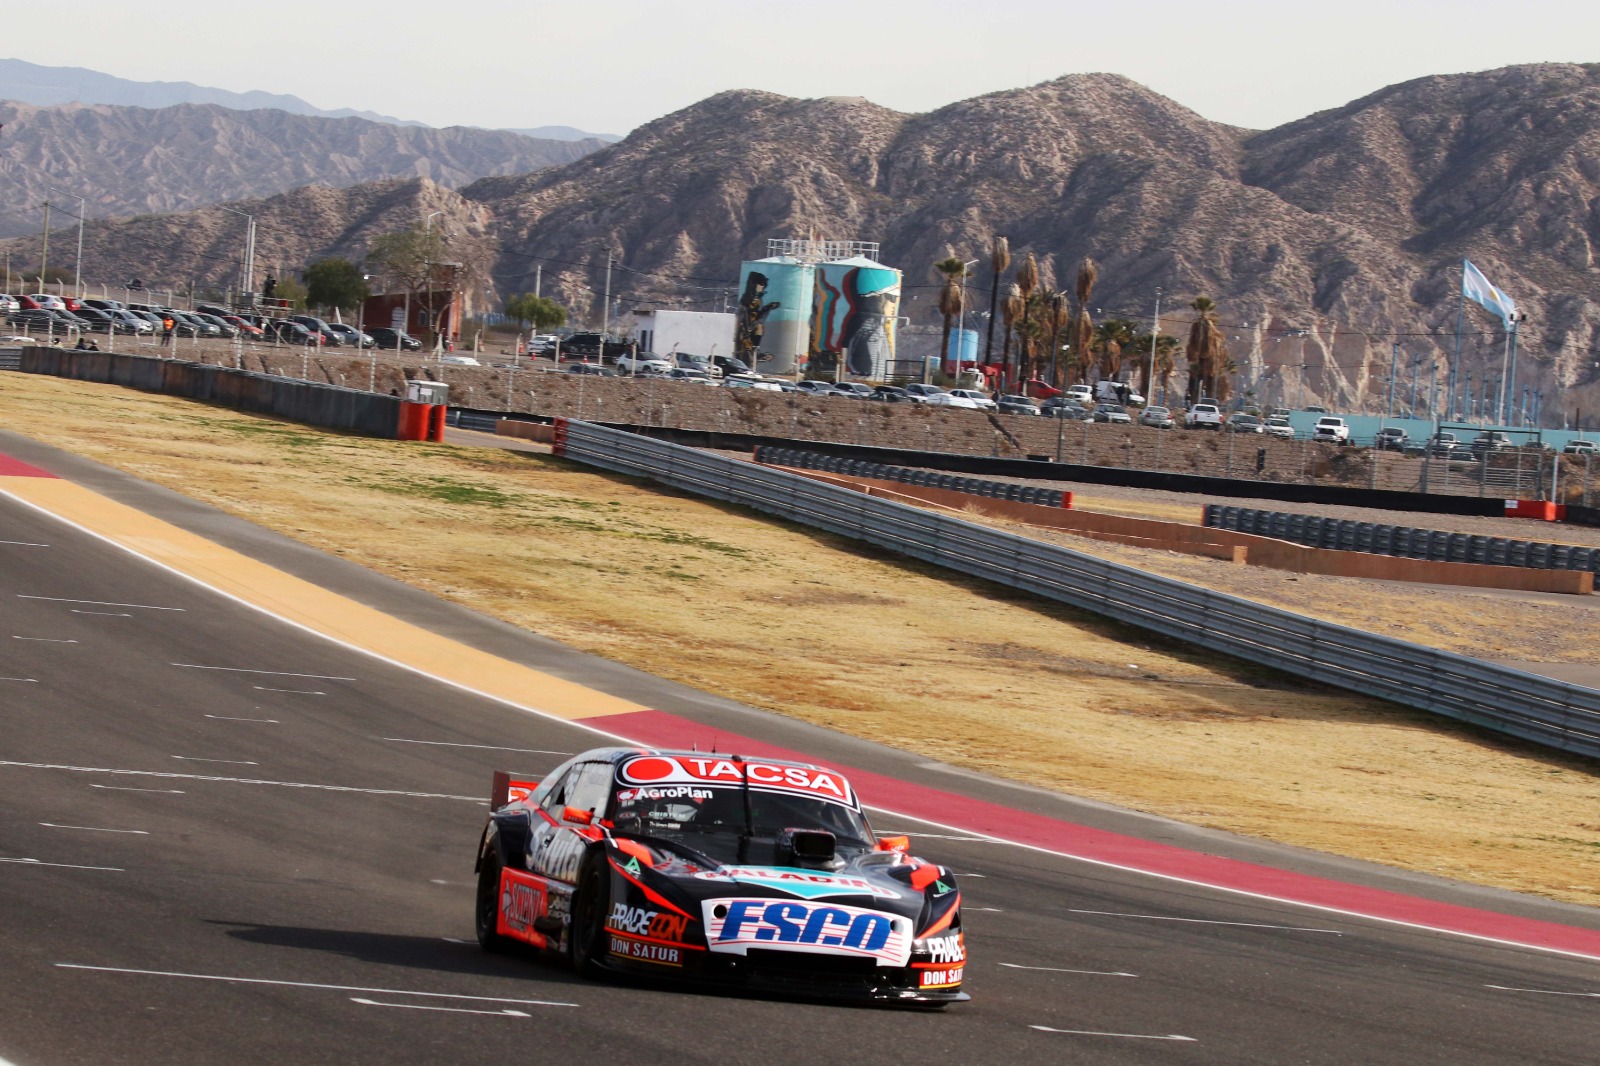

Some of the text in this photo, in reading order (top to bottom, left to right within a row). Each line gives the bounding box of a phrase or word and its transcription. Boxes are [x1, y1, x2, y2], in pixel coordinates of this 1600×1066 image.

[689, 758, 844, 797] TACSA
[637, 786, 714, 799] AgroPlan
[609, 902, 689, 942] PRADECON
[611, 938, 679, 962] DON SATUR
[923, 970, 947, 985] DON
